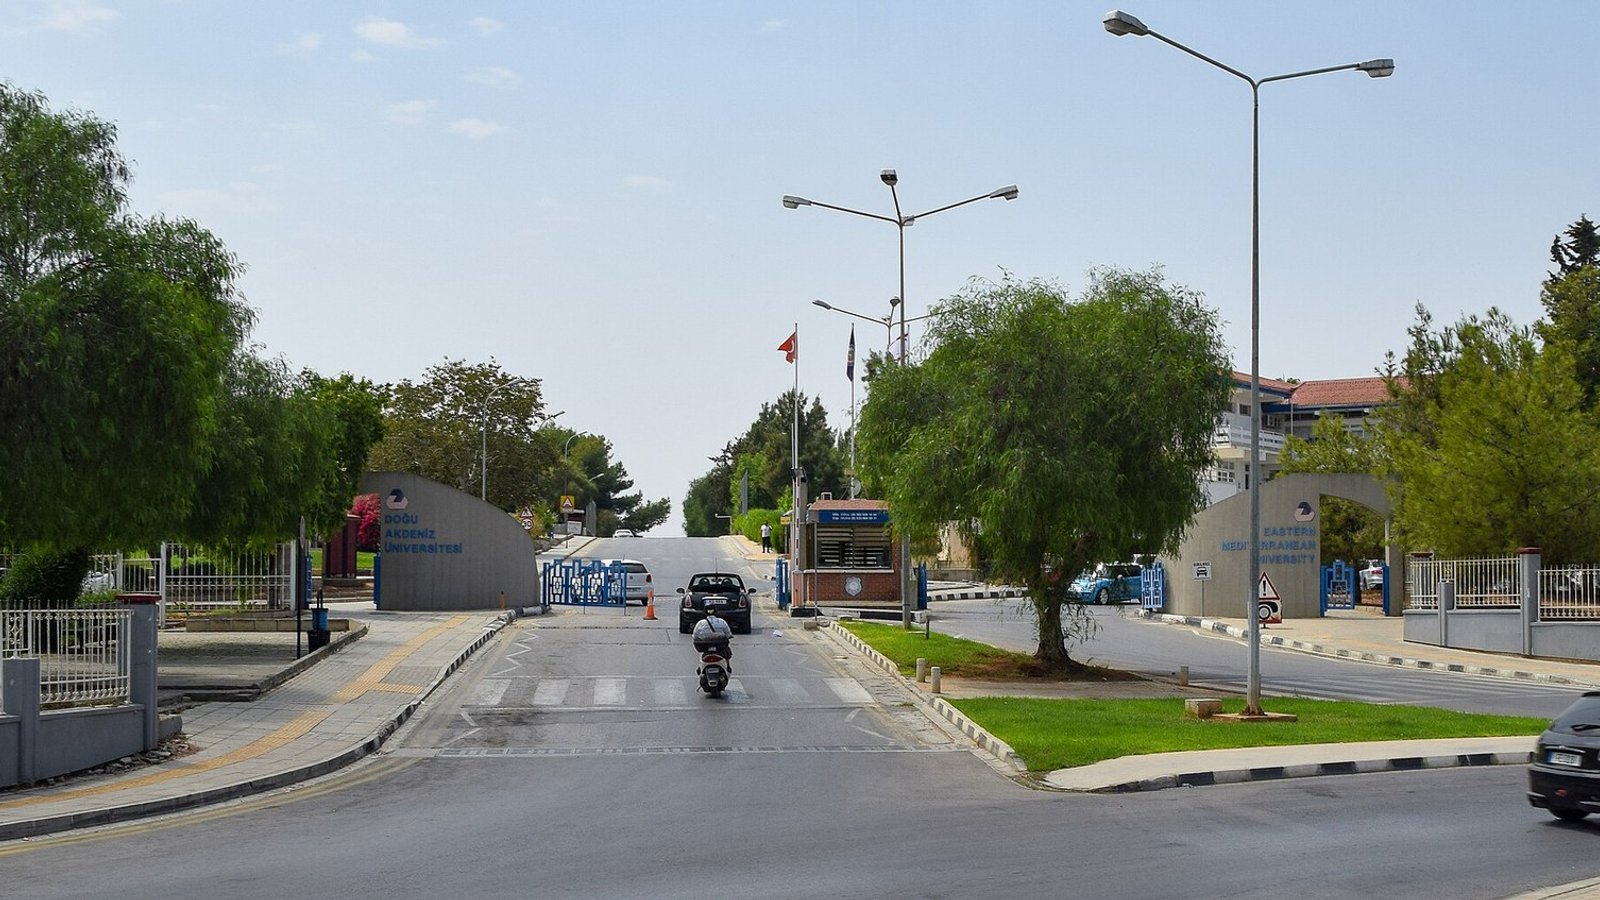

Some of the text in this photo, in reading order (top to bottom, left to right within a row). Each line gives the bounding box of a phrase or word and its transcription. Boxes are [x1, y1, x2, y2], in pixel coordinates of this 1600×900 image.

[384, 513, 418, 524] DOĞU
[385, 528, 436, 539] AKDENİZ
[1263, 527, 1317, 537] EASTERN
[1221, 540, 1317, 551] MEDIRRANEAN
[1257, 554, 1316, 565] NIVERSITY
